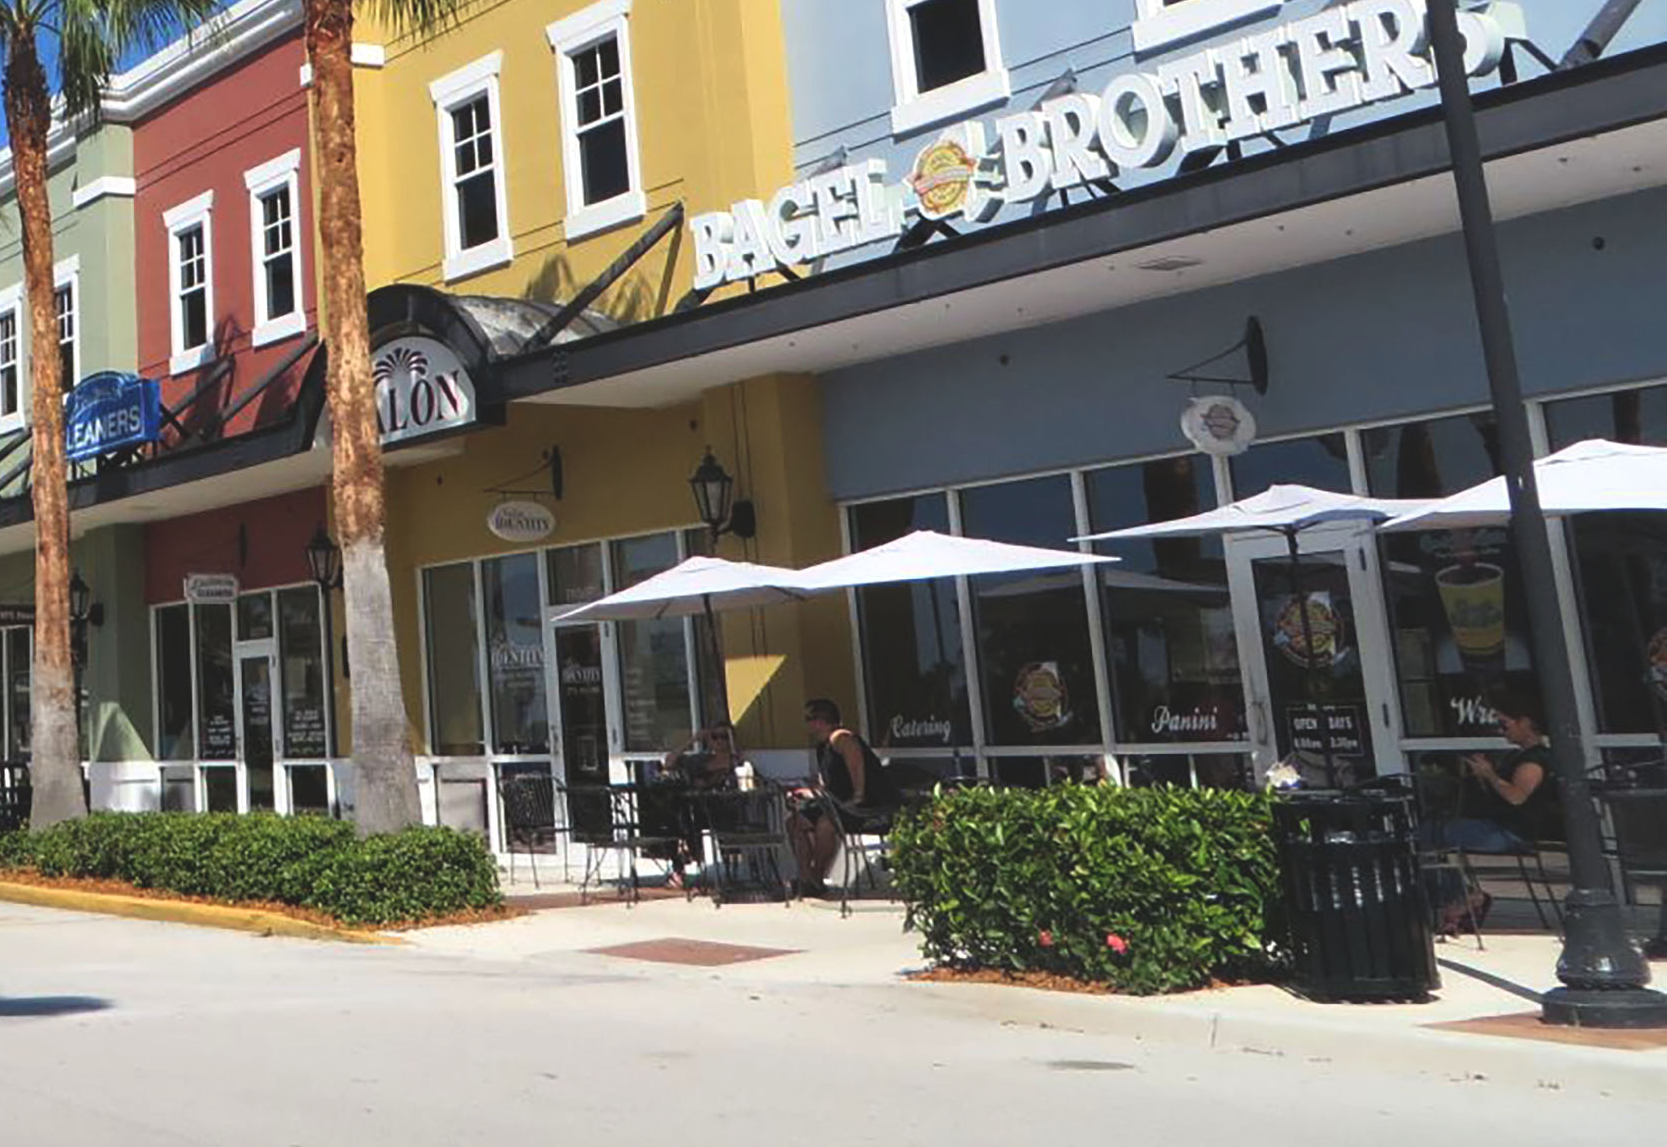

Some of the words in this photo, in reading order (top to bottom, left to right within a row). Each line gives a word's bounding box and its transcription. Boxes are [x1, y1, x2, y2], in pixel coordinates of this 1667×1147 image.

[689, 159, 905, 291] BAGEL
[376, 369, 460, 434] LON
[66, 405, 141, 451] LEANERS
[890, 713, 951, 743] Catering
[1151, 705, 1217, 734] Panini
